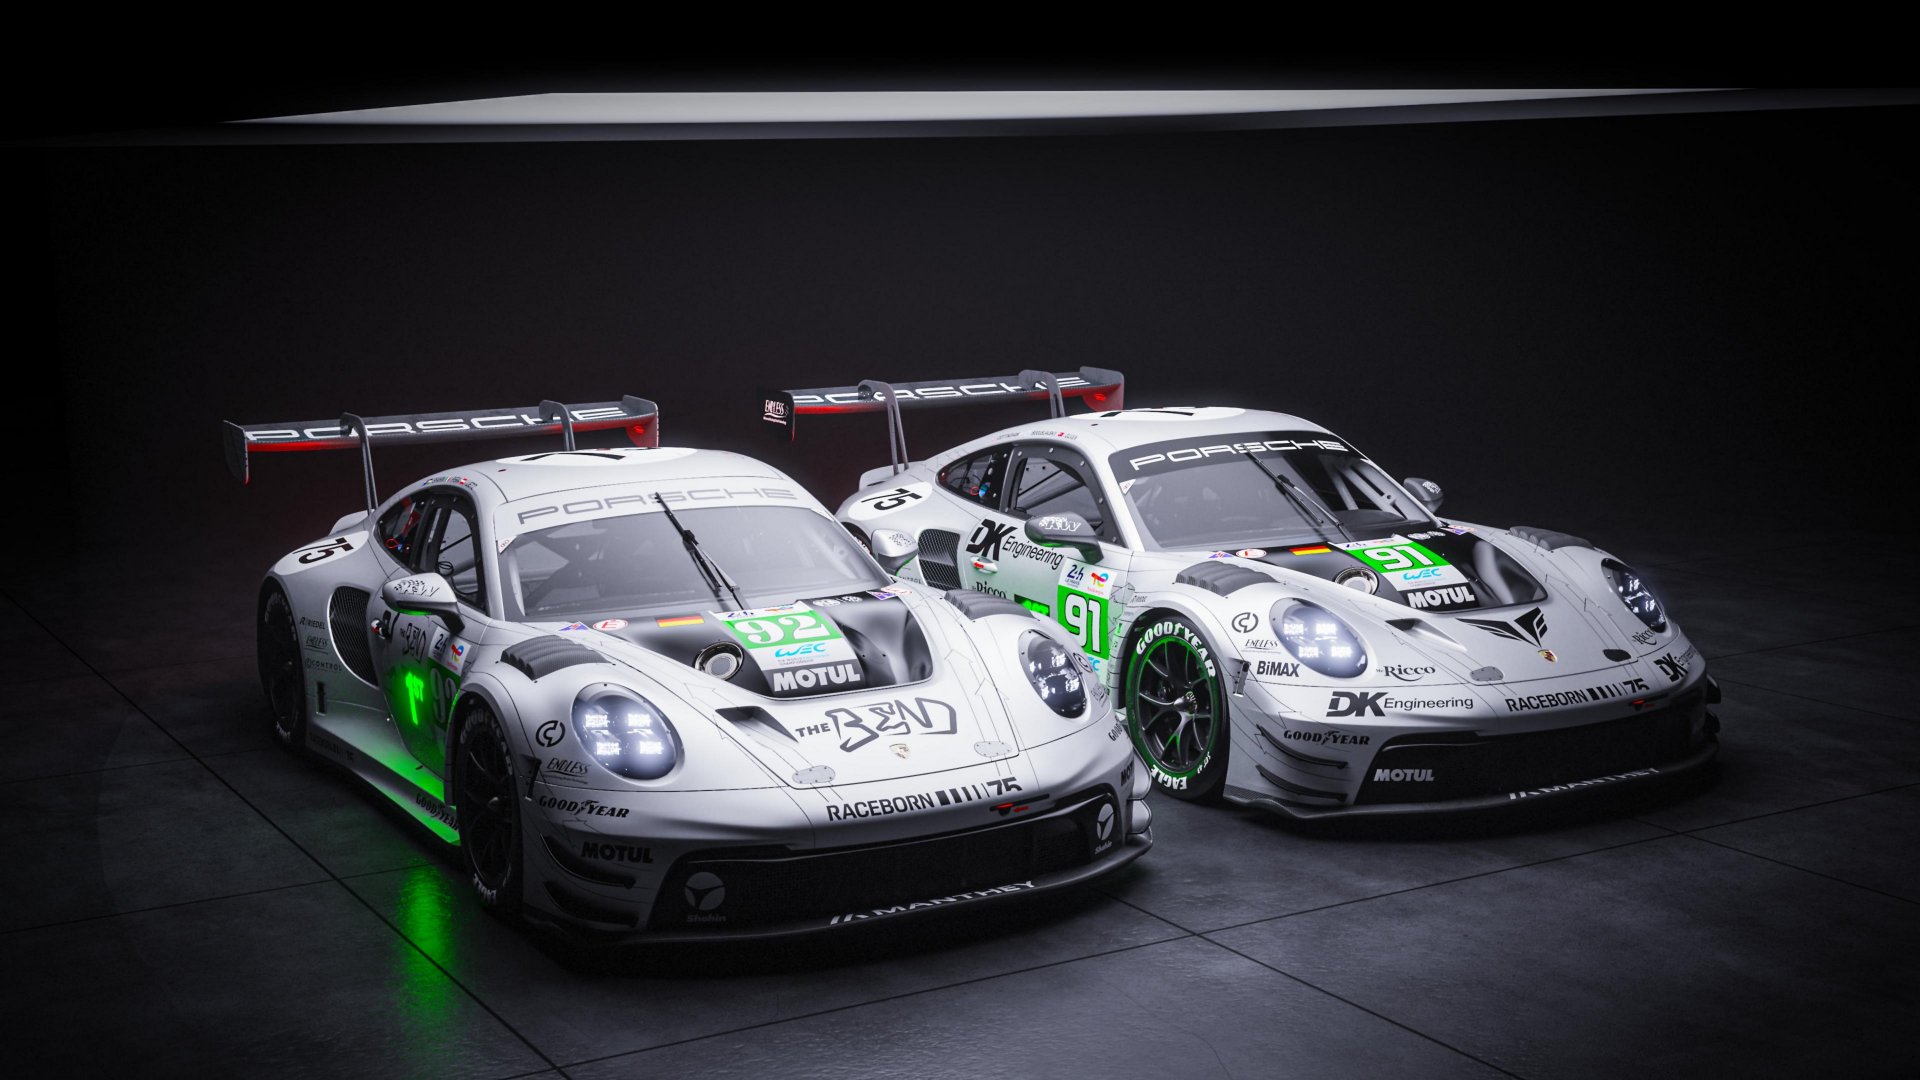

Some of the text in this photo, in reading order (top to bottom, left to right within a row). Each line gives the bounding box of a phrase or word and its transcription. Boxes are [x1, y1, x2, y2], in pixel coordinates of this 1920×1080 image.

[1129, 440, 1349, 471] PORSCHE
[517, 487, 798, 525] PORSCHE
[861, 488, 923, 511] 75
[292, 537, 354, 565] 75
[966, 518, 1018, 561] DK
[1002, 535, 1064, 571] Engineering
[1363, 544, 1435, 571] 91
[1403, 567, 1443, 581] WEC
[1407, 585, 1476, 609] MOTUL
[734, 615, 831, 645] 92
[1065, 592, 1101, 654] 91
[775, 642, 828, 658] WEC
[1136, 621, 1217, 678] GOODYEAR
[1245, 639, 1279, 649] ENDLESS
[773, 663, 861, 693] MOTUL
[1257, 660, 1300, 677] BiMAX
[1384, 664, 1436, 682] Ricco
[1654, 653, 1690, 683] DK
[1623, 678, 1650, 694] 75
[1326, 691, 1474, 717] DK Engineering
[1505, 689, 1588, 712] RACEBORN
[795, 722, 831, 743] THE
[1283, 730, 1371, 746] GOODYEAR
[547, 757, 592, 775] ENDLESS
[1151, 764, 1187, 790] EAGLE
[1373, 768, 1436, 783] MOTUL
[986, 775, 1023, 796] 75
[538, 795, 631, 818] GOODYEAR
[826, 791, 936, 822] RACEBORN
[580, 841, 654, 864] MOTUL
[872, 880, 1035, 916] MANTHEY
